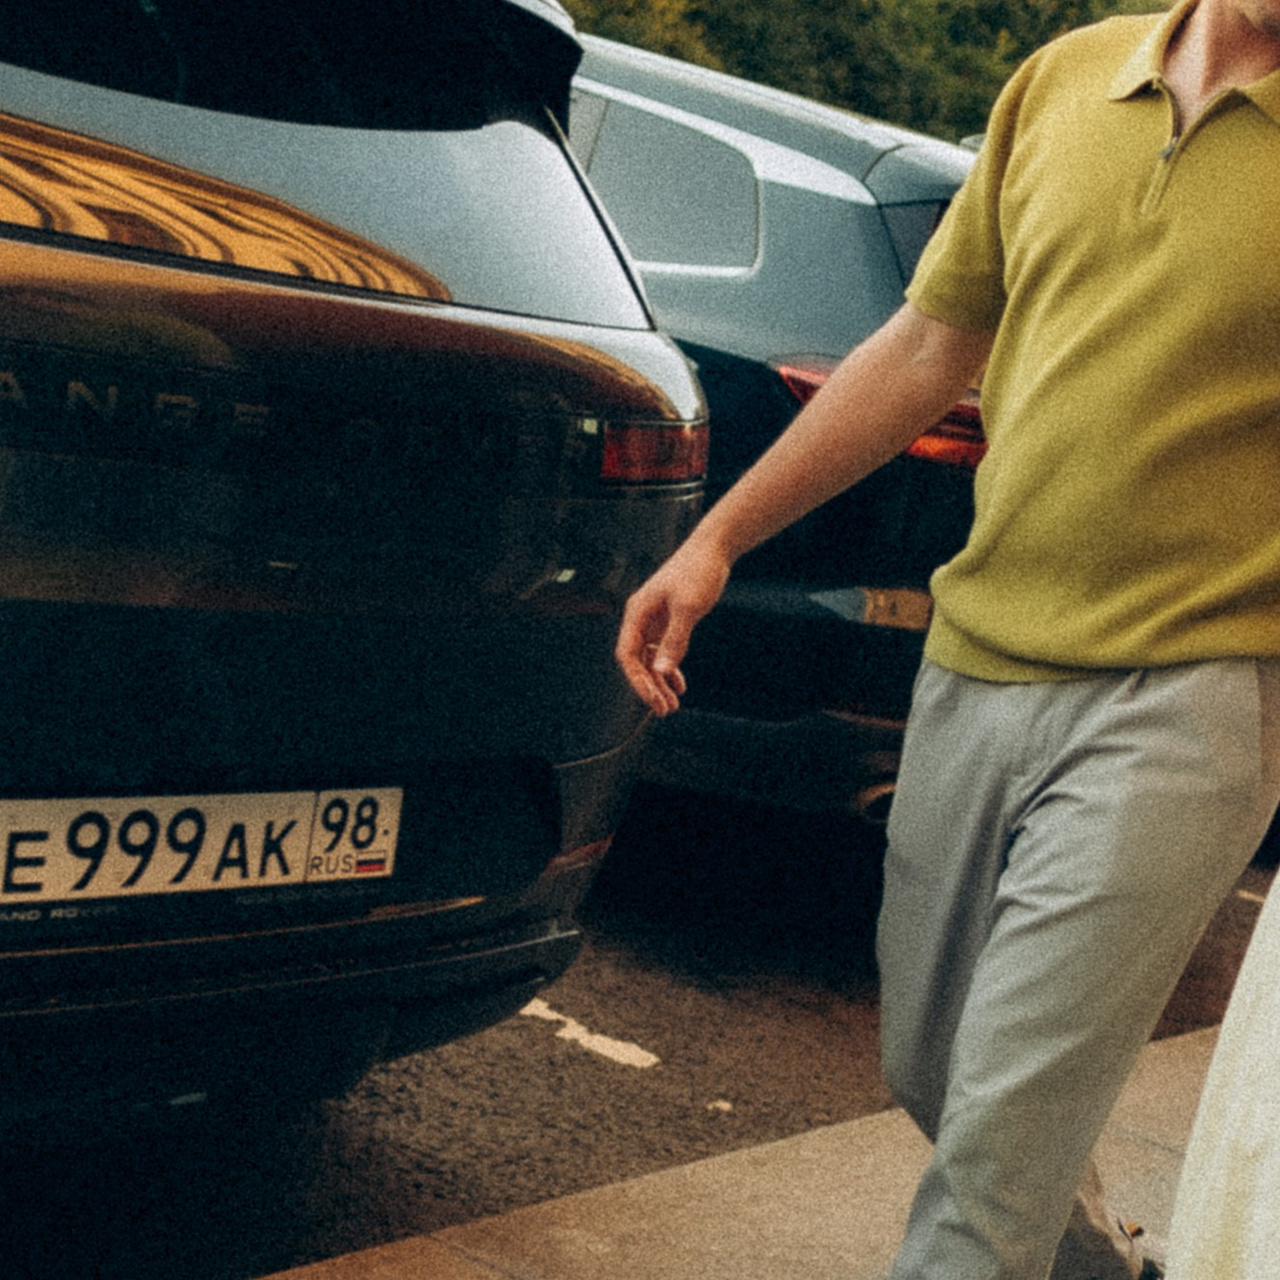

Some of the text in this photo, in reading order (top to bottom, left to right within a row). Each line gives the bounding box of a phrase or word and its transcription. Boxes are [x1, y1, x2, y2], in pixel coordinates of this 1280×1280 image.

[2, 806, 297, 893] E999AK
[321, 796, 380, 853] 98
[309, 856, 354, 875] RUS
